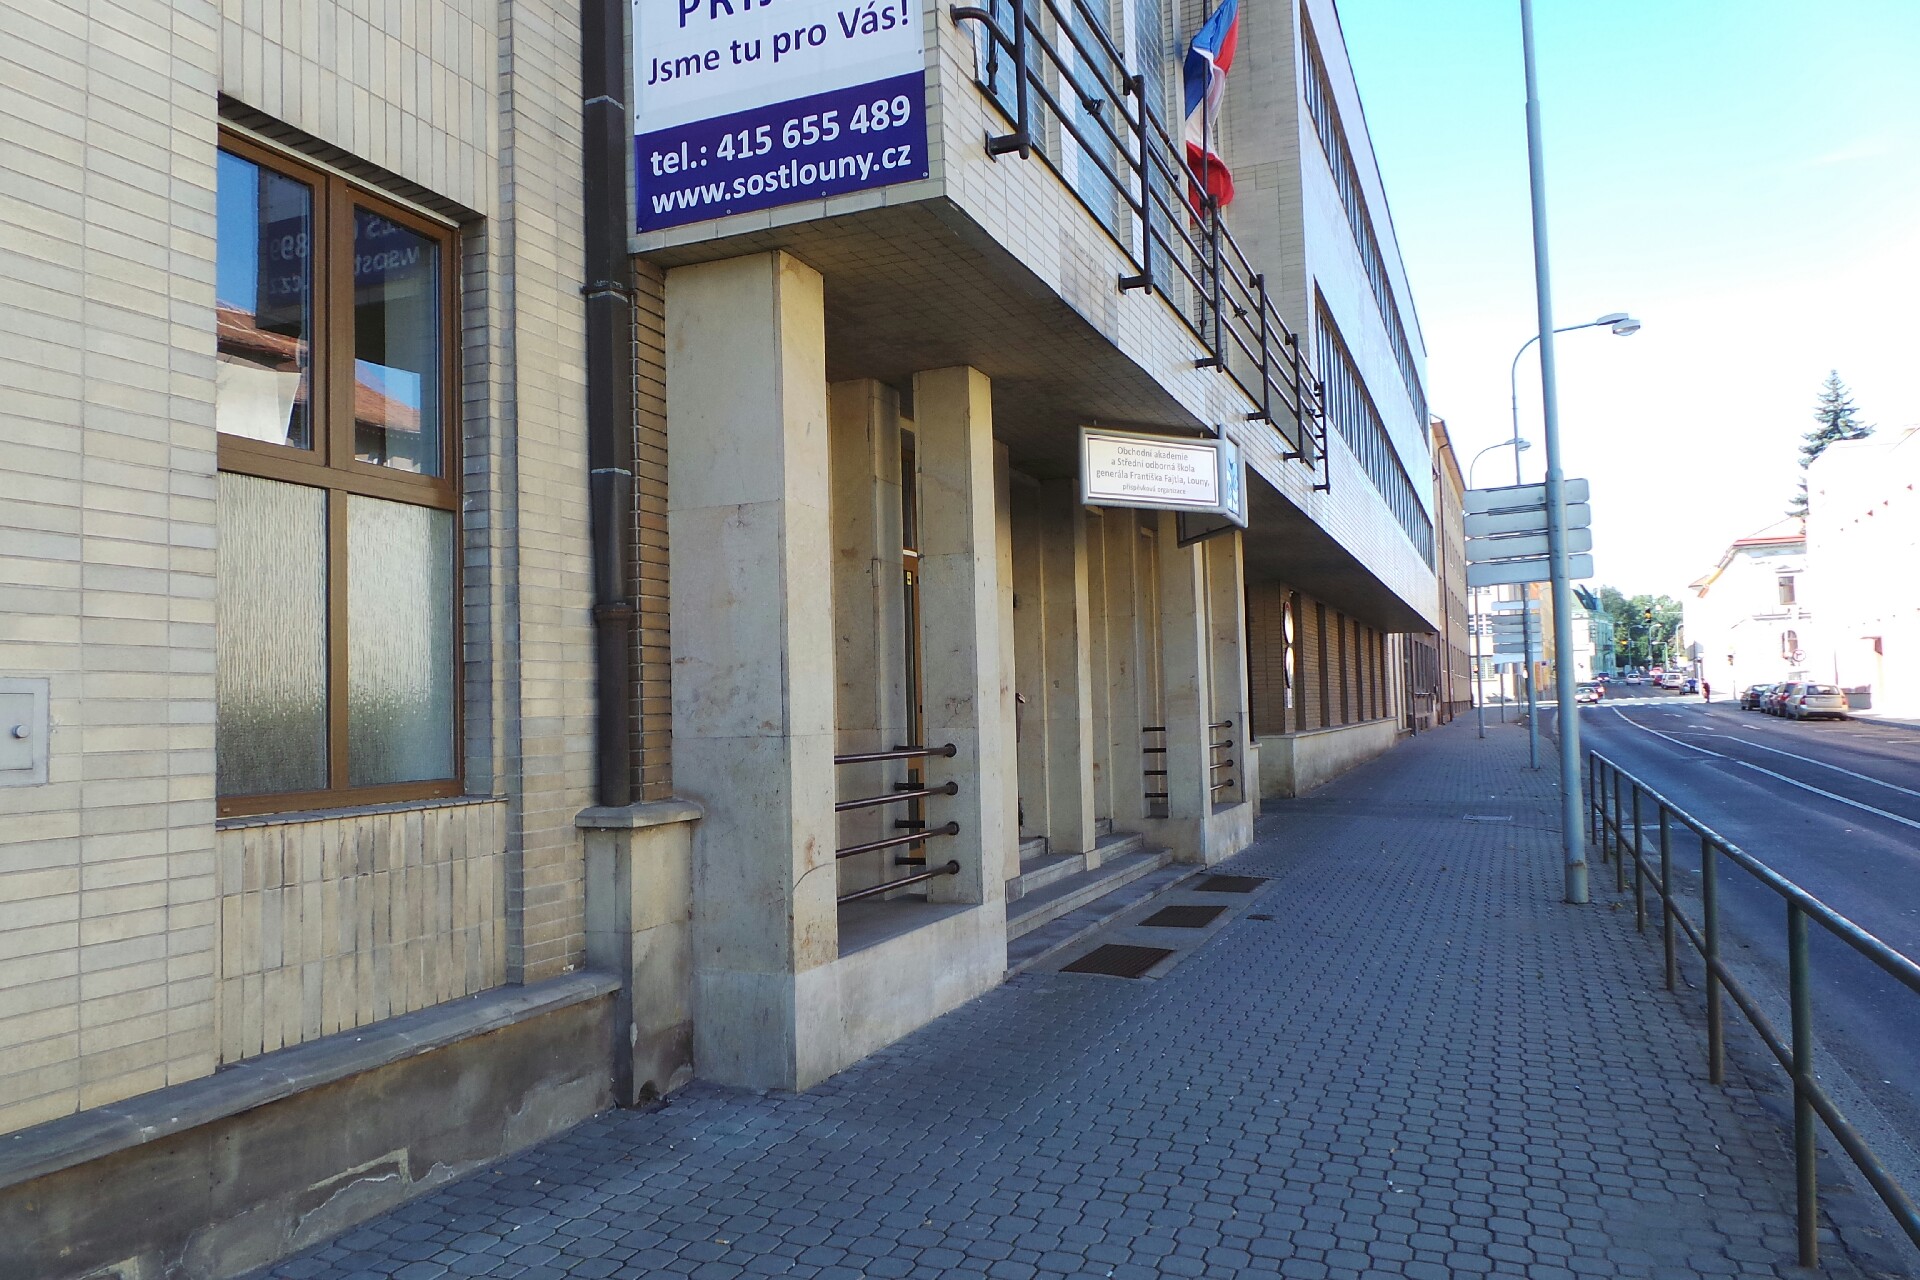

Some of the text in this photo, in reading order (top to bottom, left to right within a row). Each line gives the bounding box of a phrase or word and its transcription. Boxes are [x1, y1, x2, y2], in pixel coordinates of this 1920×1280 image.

[648, 1, 910, 86] Jsme tu pro Vás!
[650, 95, 911, 177] tel.: 415 655 489
[651, 143, 912, 214] www.sostlouny.cz
[1117, 446, 1189, 461] Obchodní akademie
[1145, 460, 1176, 471] odborná
[1177, 462, 1196, 473] škola
[1096, 469, 1129, 479] generála
[1129, 471, 1163, 482] Františka
[1164, 473, 1186, 486] Fajtla,
[1157, 486, 1187, 495] organizace
